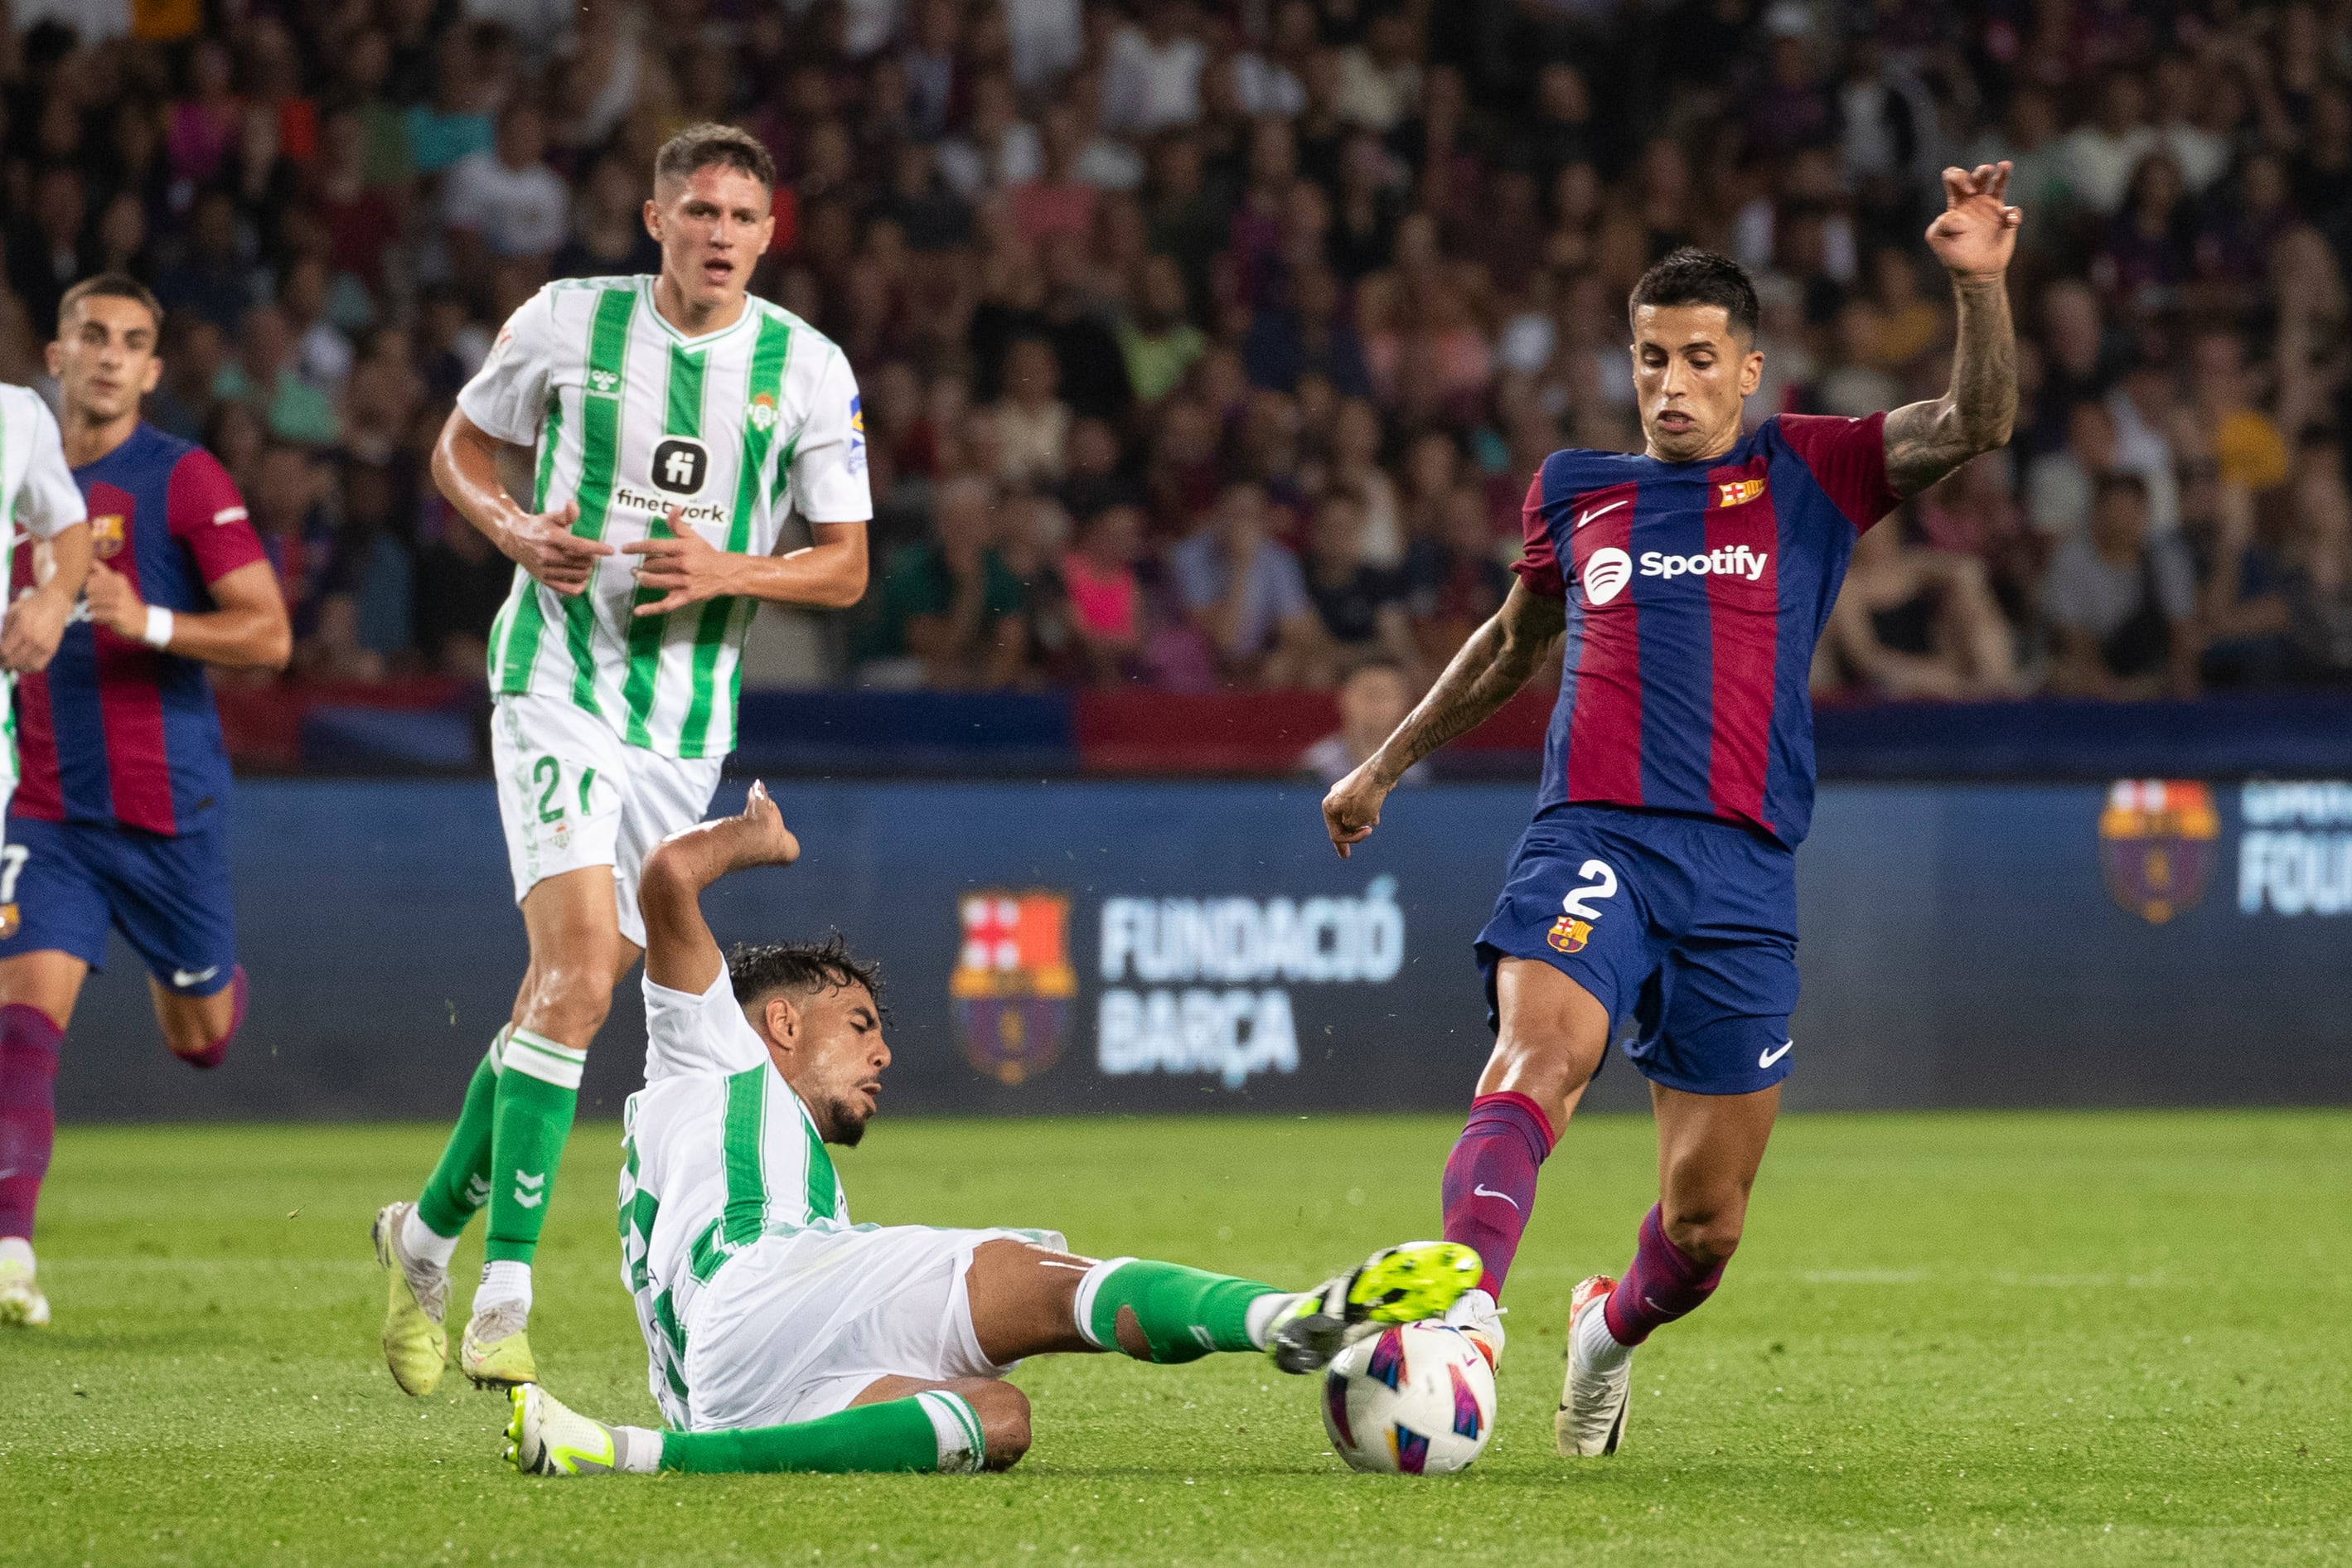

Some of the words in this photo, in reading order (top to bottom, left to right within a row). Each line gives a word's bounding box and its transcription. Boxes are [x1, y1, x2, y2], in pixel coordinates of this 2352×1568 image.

[1639, 545, 1768, 581] Spotify
[0, 844, 30, 903] 7
[1562, 859, 1618, 920] 2
[1101, 876, 1405, 983] FUNDACIÓ
[1099, 990, 1299, 1089] BARÇA
